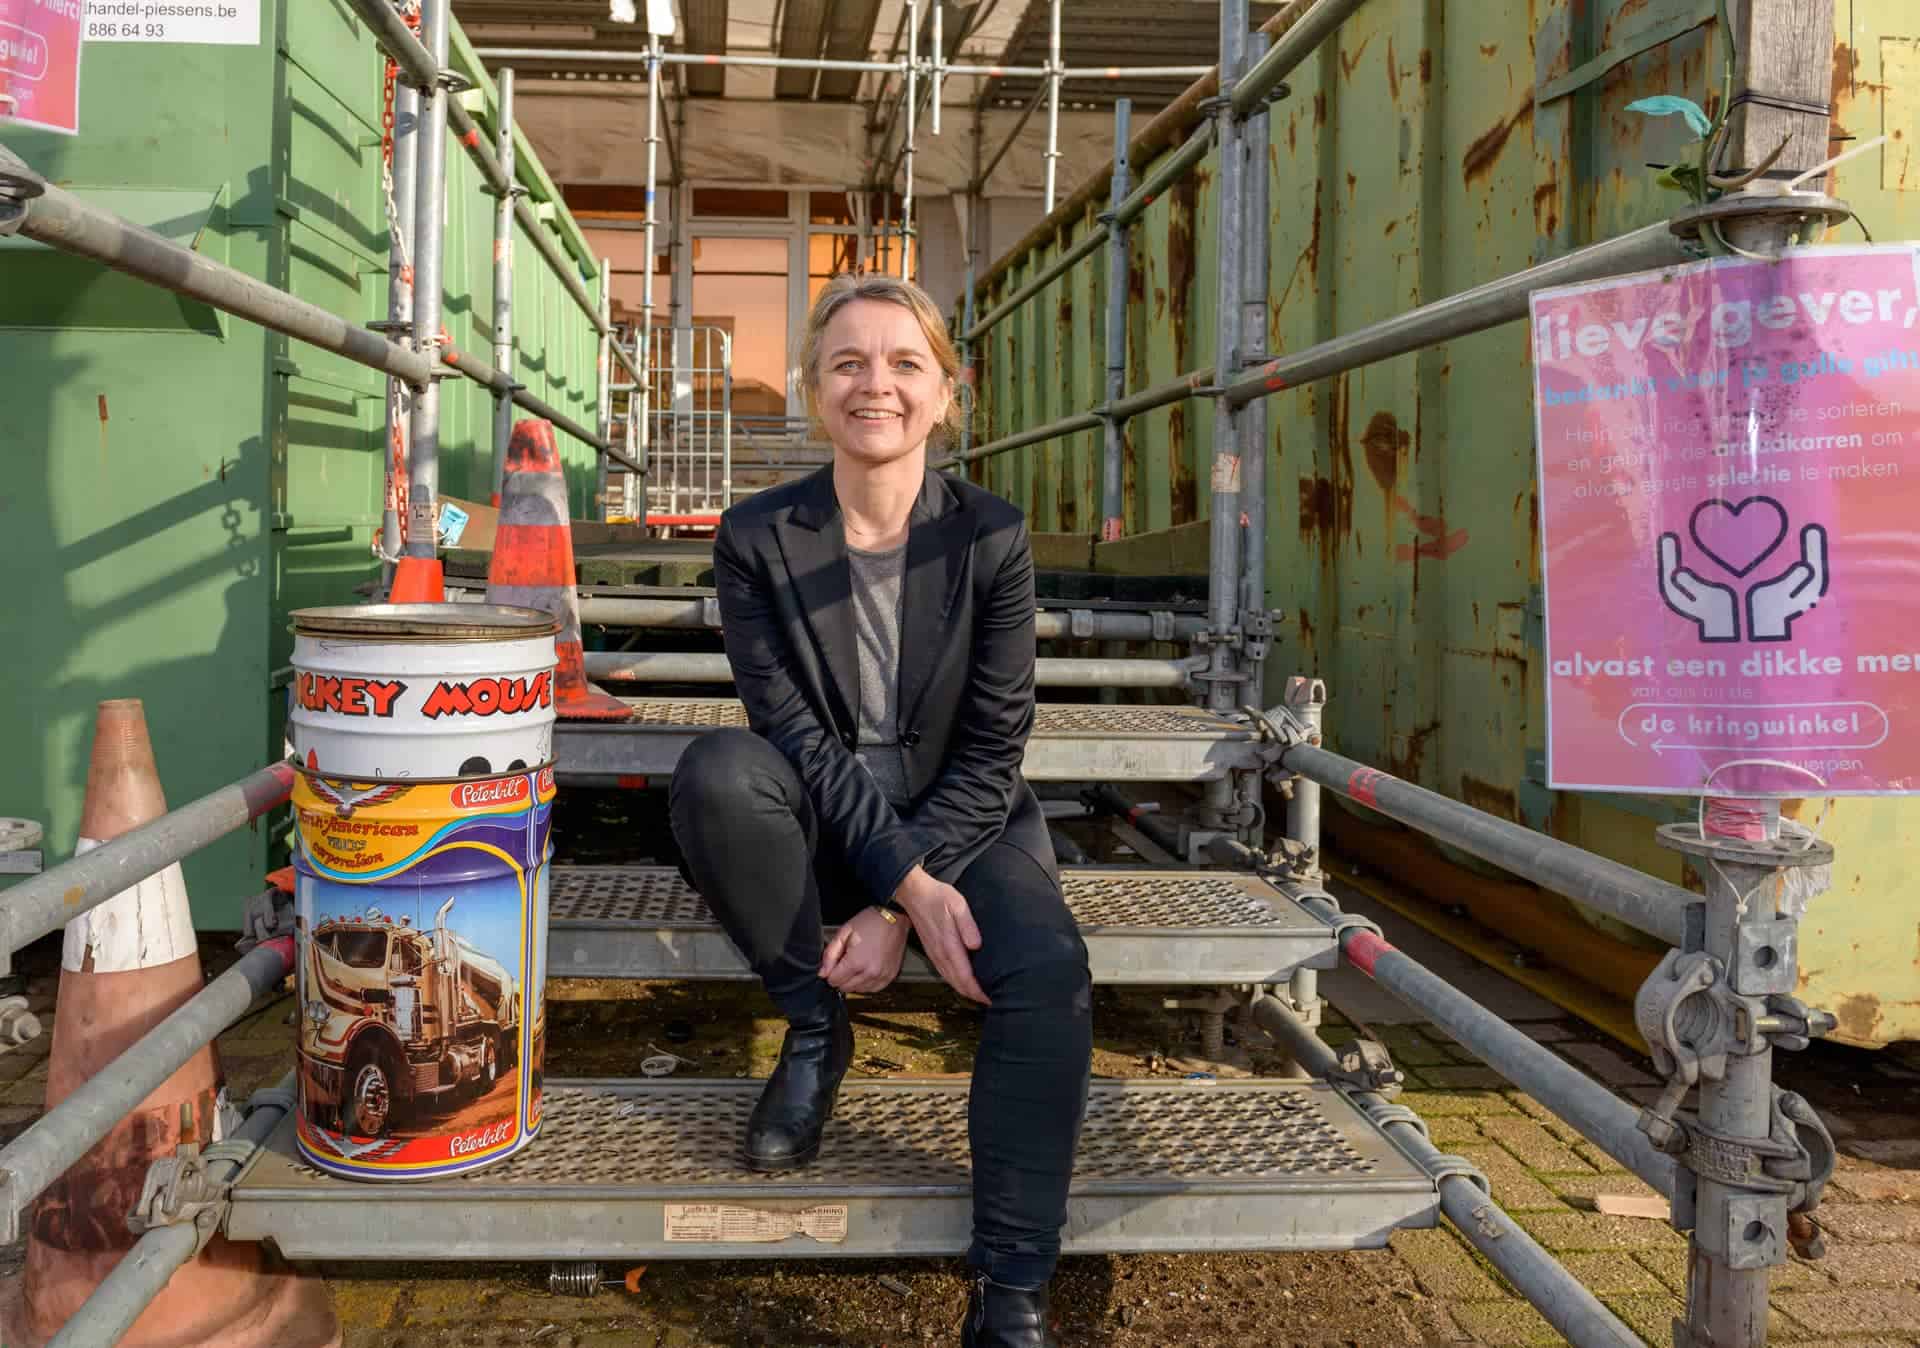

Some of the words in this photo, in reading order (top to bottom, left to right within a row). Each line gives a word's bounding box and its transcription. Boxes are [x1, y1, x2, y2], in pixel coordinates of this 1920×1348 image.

[88, 23, 117, 36] 886
[122, 23, 140, 36] 64
[145, 24, 164, 37] 93
[1539, 310, 1686, 361] lieve
[1710, 286, 1917, 350] gever,
[1544, 375, 1657, 407] bedankt
[1667, 370, 1729, 392] voor
[1743, 361, 1768, 387] je
[1780, 351, 1856, 384] gulle
[1815, 399, 1902, 420] sorteren
[1567, 457, 1591, 473] en
[1871, 431, 1904, 448] om
[1707, 463, 1792, 489] selectie
[1801, 465, 1819, 481] te
[1828, 455, 1900, 480] maken
[1552, 651, 1655, 677] alvast
[1667, 658, 1727, 677] een
[1740, 648, 1843, 677] dikke
[420, 669, 552, 721] MOUSE
[1640, 712, 1677, 734] de
[1688, 710, 1861, 742] kringwinkel
[461, 777, 527, 807] Peterbilt
[449, 1121, 513, 1157] Peterbilt
